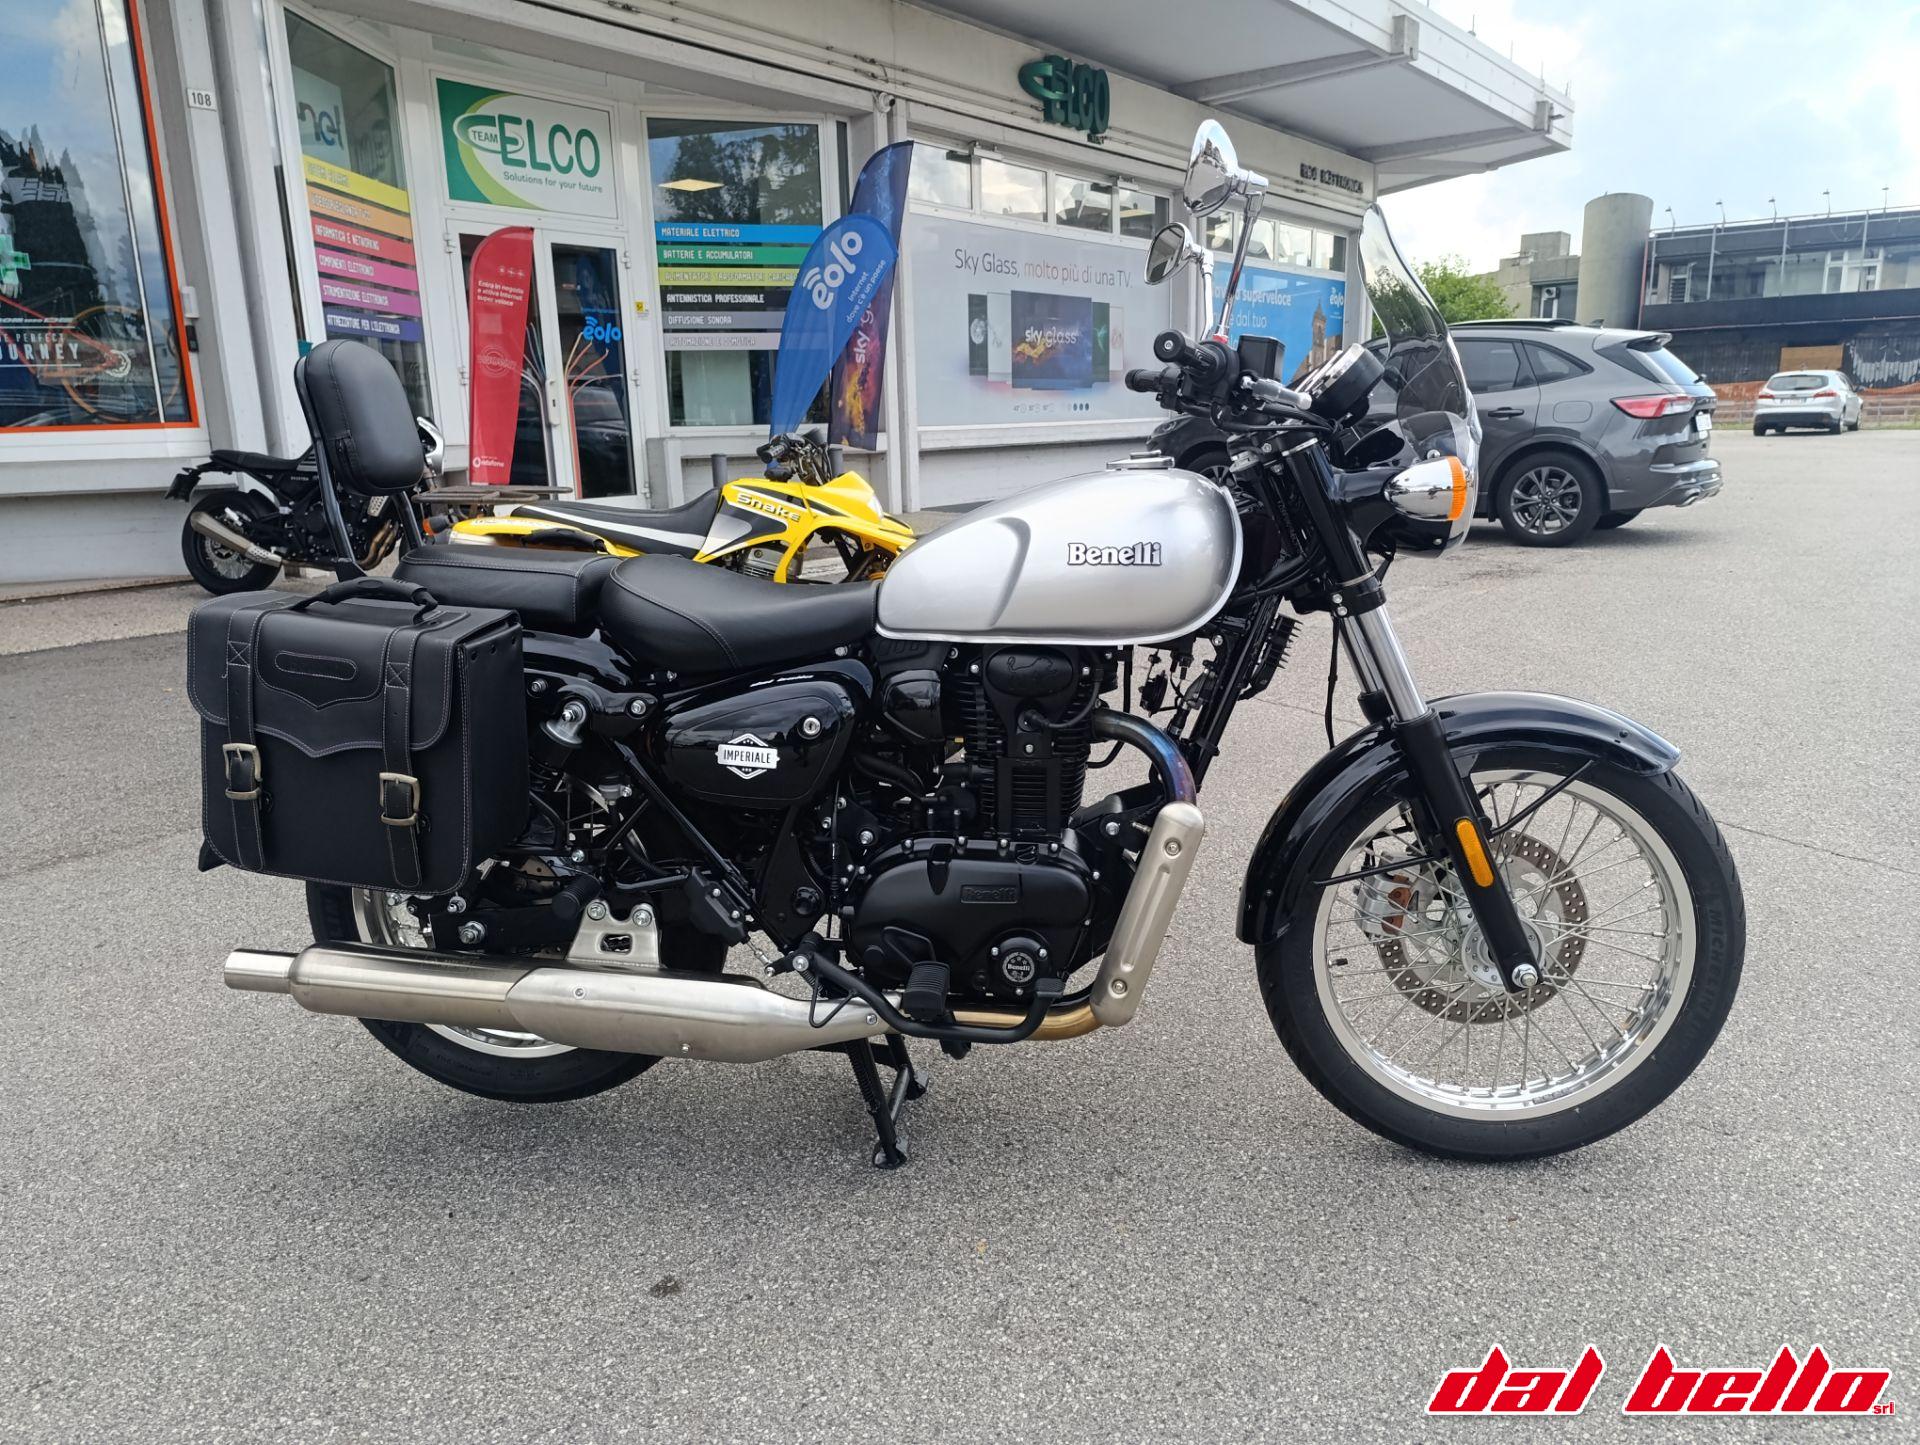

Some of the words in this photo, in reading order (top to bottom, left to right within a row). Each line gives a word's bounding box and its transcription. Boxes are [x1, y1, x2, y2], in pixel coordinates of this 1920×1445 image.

[191, 92, 212, 107] 108
[472, 129, 499, 144] TEAM
[497, 114, 601, 178] ELCO
[503, 171, 544, 186] Solutions
[545, 176, 557, 187] for
[558, 180, 577, 191] your
[578, 182, 604, 194] future
[661, 227, 699, 238] MATERIALE
[702, 228, 740, 239] ELETTRICO
[663, 249, 695, 260] BATTERIE
[697, 250, 703, 260] E
[705, 250, 753, 261] ACCUMULATORI
[803, 231, 864, 310] eolo
[954, 248, 979, 276] Sky
[981, 252, 1020, 278] Glass,
[1024, 259, 1059, 281] molto
[1061, 263, 1079, 285] più
[1081, 265, 1093, 284] di
[1094, 269, 1115, 287] una
[1117, 269, 1134, 289] TV.
[666, 293, 713, 304] ANTENNISTICA
[714, 293, 765, 304] PROFESSIONALE
[846, 305, 861, 324] dove
[870, 259, 886, 286] paese
[1242, 289, 1292, 308] superveloce
[668, 315, 705, 326] DIFFUSIONE
[707, 316, 732, 326] SONORA
[1235, 310, 1250, 327] dal
[1252, 312, 1268, 329] tuo
[16, 332, 65, 344] PERFECT
[582, 316, 622, 344] eolo
[1024, 326, 1043, 346] sky
[1044, 326, 1078, 348] glass
[854, 331, 871, 365] sky
[737, 491, 801, 523] Snake
[1067, 541, 1162, 567] Benelli
[723, 749, 772, 764] IMPERIALE
[1007, 962, 1031, 972] Benelli
